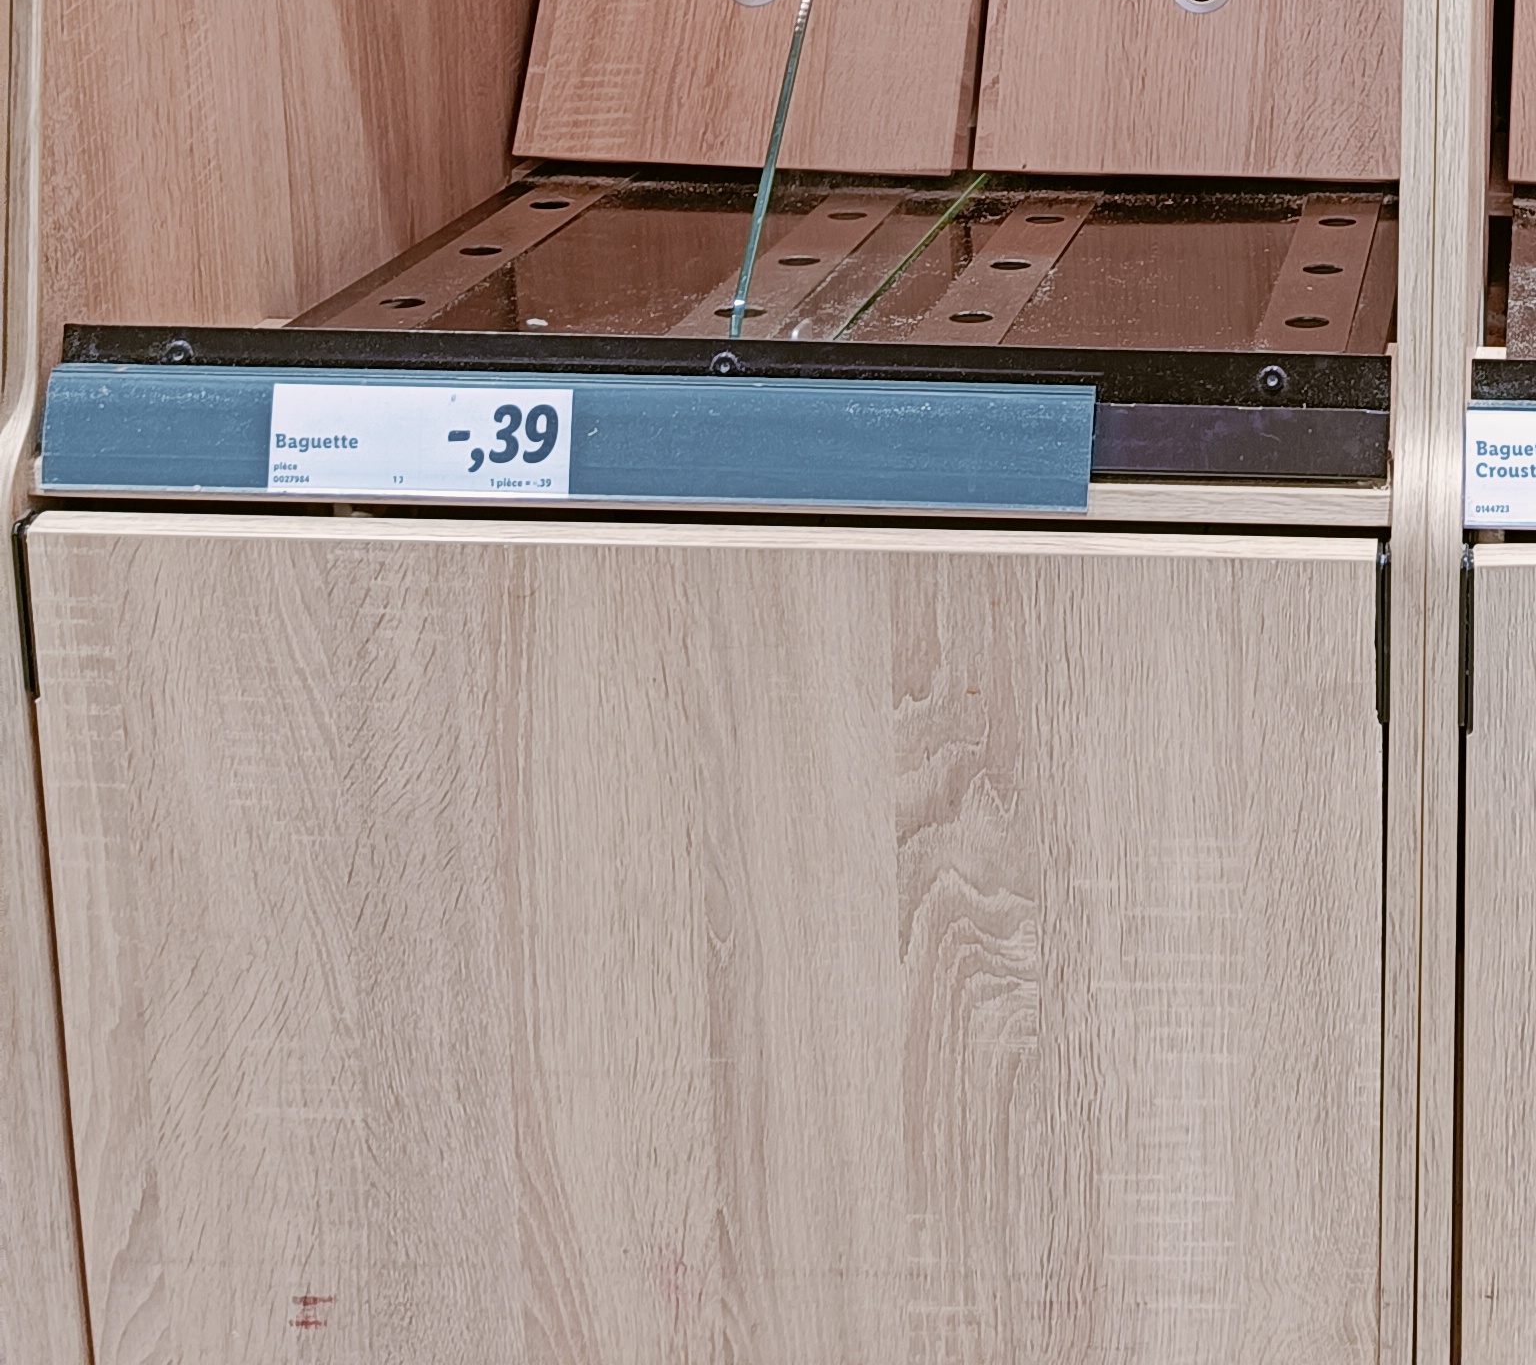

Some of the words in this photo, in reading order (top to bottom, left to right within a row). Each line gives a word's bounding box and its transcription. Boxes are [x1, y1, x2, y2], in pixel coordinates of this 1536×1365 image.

[275, 433, 359, 453] Baguette
[447, 403, 559, 473] -,39
[273, 462, 298, 472] pièce
[496, 478, 523, 489] pièce
